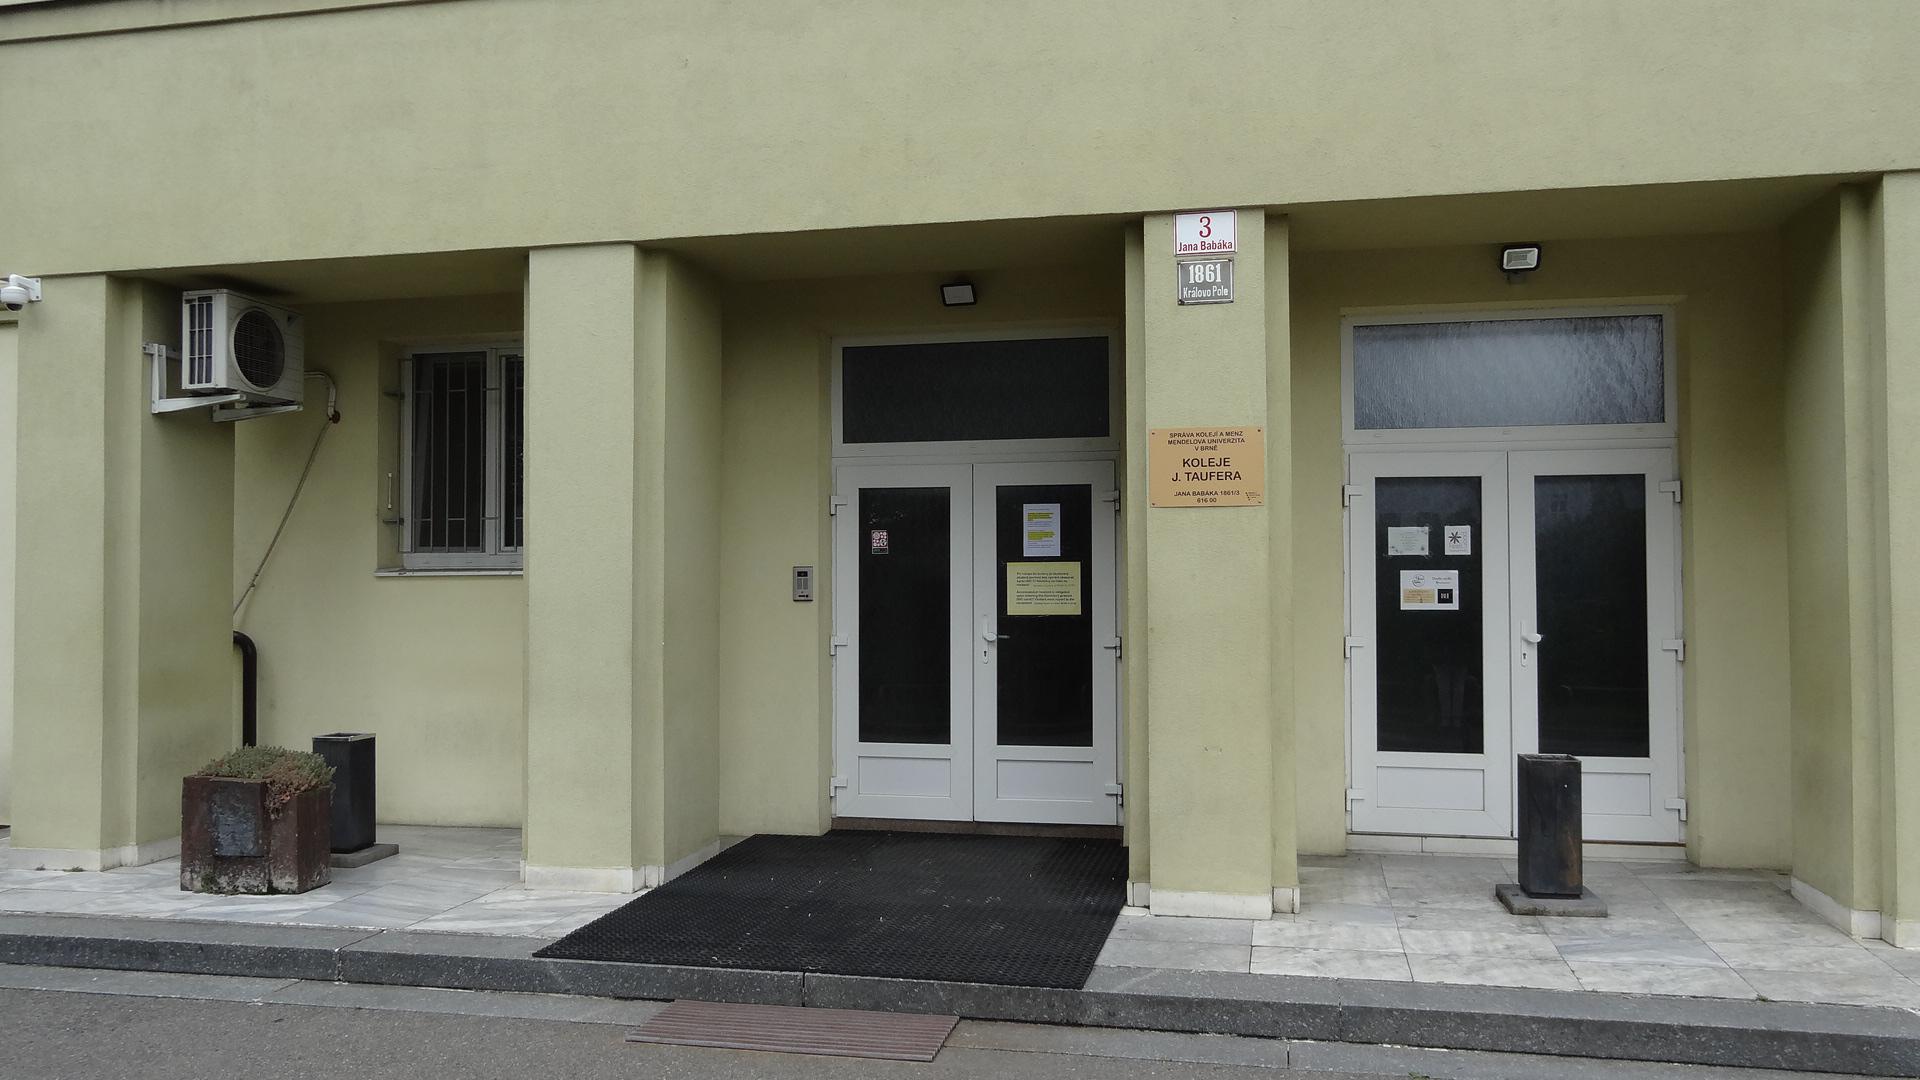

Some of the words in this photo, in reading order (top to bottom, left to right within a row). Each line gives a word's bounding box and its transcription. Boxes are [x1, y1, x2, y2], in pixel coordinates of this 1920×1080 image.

[1199, 216, 1212, 238] 3
[1178, 242, 1198, 252] Jana
[1200, 239, 1233, 251] Babáka
[1188, 263, 1222, 284] 1861
[1183, 286, 1211, 299] Královo
[1212, 285, 1229, 297] Pole
[1169, 431, 1195, 439] SPRÁVA
[1182, 457, 1231, 468] KOLEJE
[1171, 472, 1181, 482] J.
[1184, 471, 1242, 481] TAUFERA
